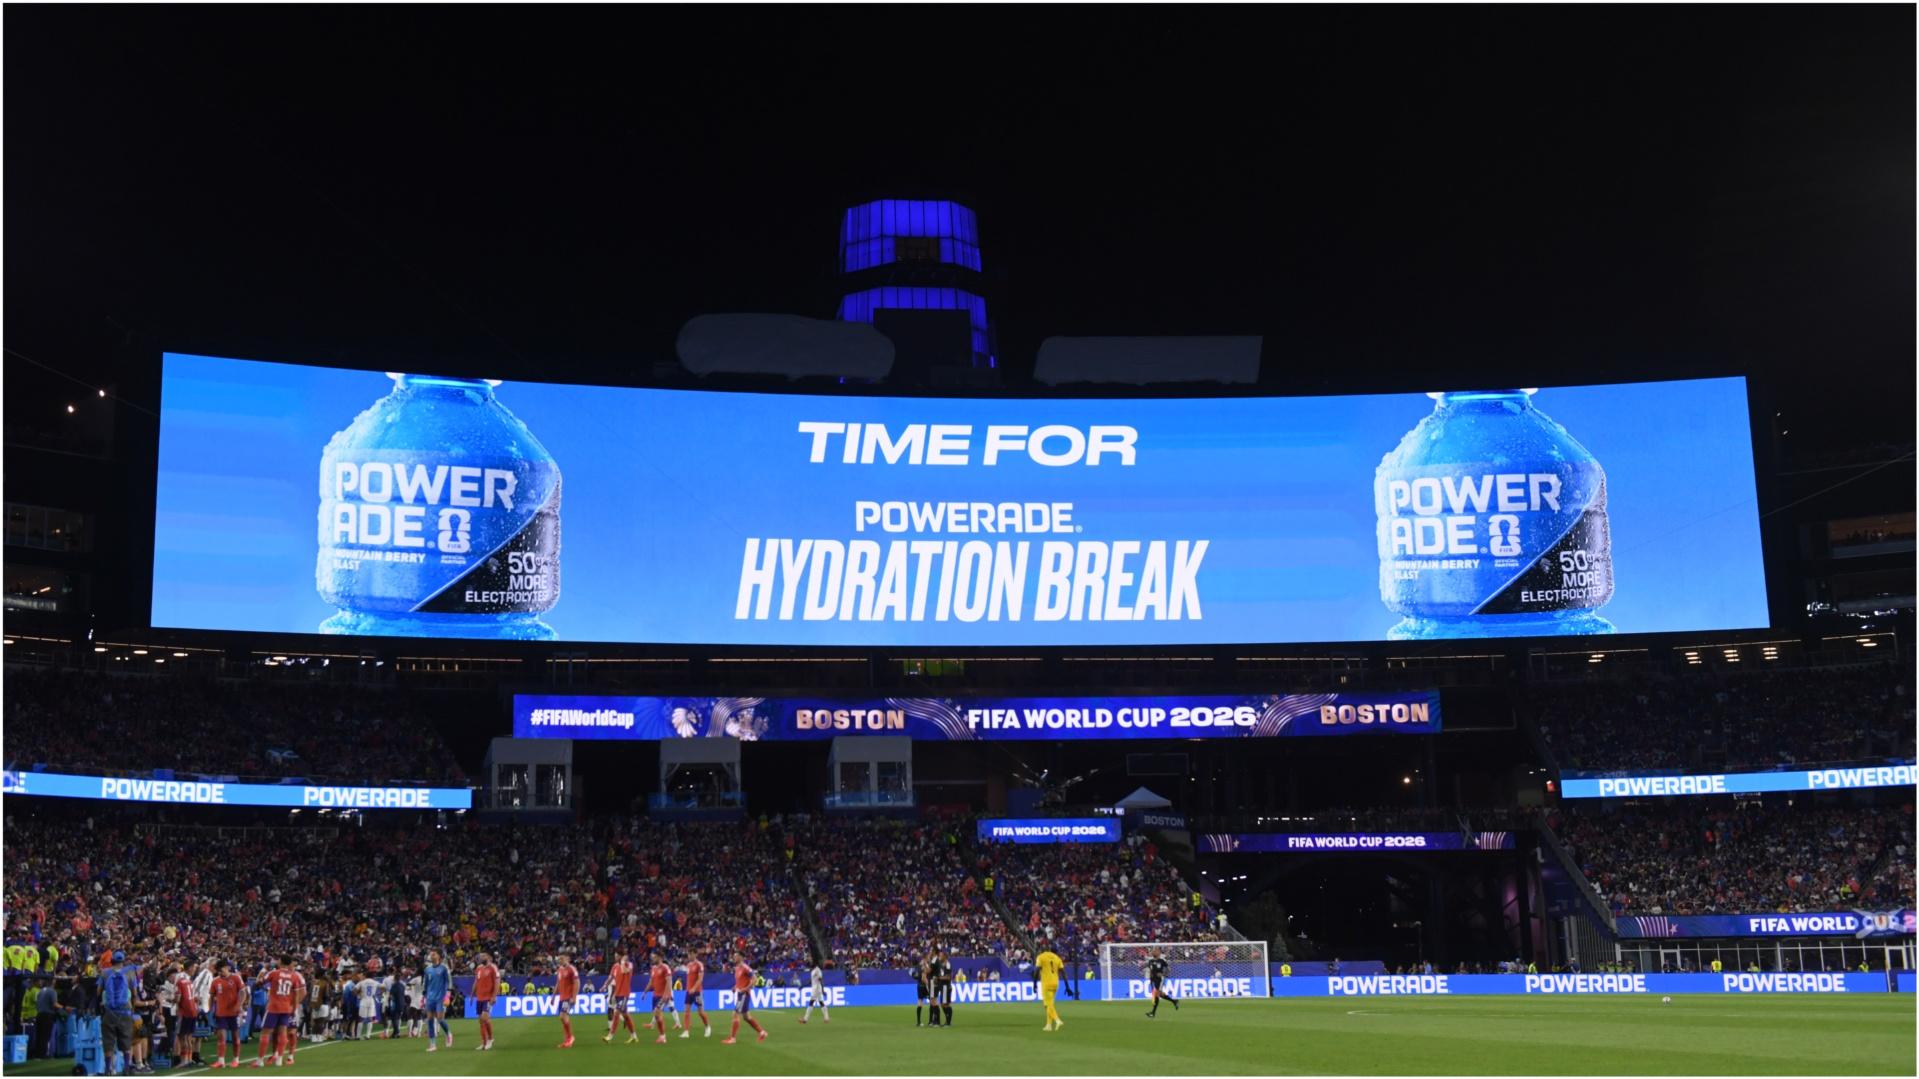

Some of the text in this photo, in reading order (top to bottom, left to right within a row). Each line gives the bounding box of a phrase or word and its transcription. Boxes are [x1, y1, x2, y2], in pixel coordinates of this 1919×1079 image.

[799, 422, 1138, 467] TIME FOR
[335, 462, 518, 512] POWER
[1389, 473, 1562, 516] POWER
[334, 503, 426, 547] ADE
[855, 501, 1074, 533] POWERADE
[1391, 515, 1478, 555] ADE
[385, 551, 426, 563] BERRY
[1441, 558, 1480, 569] BERRY
[510, 574, 547, 591] MORE
[735, 537, 1210, 623] HYDRATION BREAK
[1562, 570, 1600, 588] MORE
[530, 709, 634, 728] #FIFAWorldCup
[796, 709, 904, 730] BOSTON
[968, 706, 1257, 729] FIFA WORLD CUP 2026
[1320, 703, 1428, 725] BOSTON
[102, 777, 225, 804] POWERADE
[1599, 775, 1726, 797] POWERADE
[303, 786, 430, 808] POWERADE
[993, 825, 1106, 837] FIFA WORLD CUP 2026
[1143, 815, 1184, 828] BOSTON
[1288, 836, 1426, 848] FIFA WORLD CUP 2026
[1750, 917, 1790, 933] FIFA
[1791, 915, 1859, 932] WORLD
[276, 979, 293, 996] 10
[1329, 975, 1449, 995] POWERADE
[1525, 974, 1647, 993] POWERADE
[1723, 973, 1846, 992] POWERADE
[506, 993, 636, 1016] POWRAE
